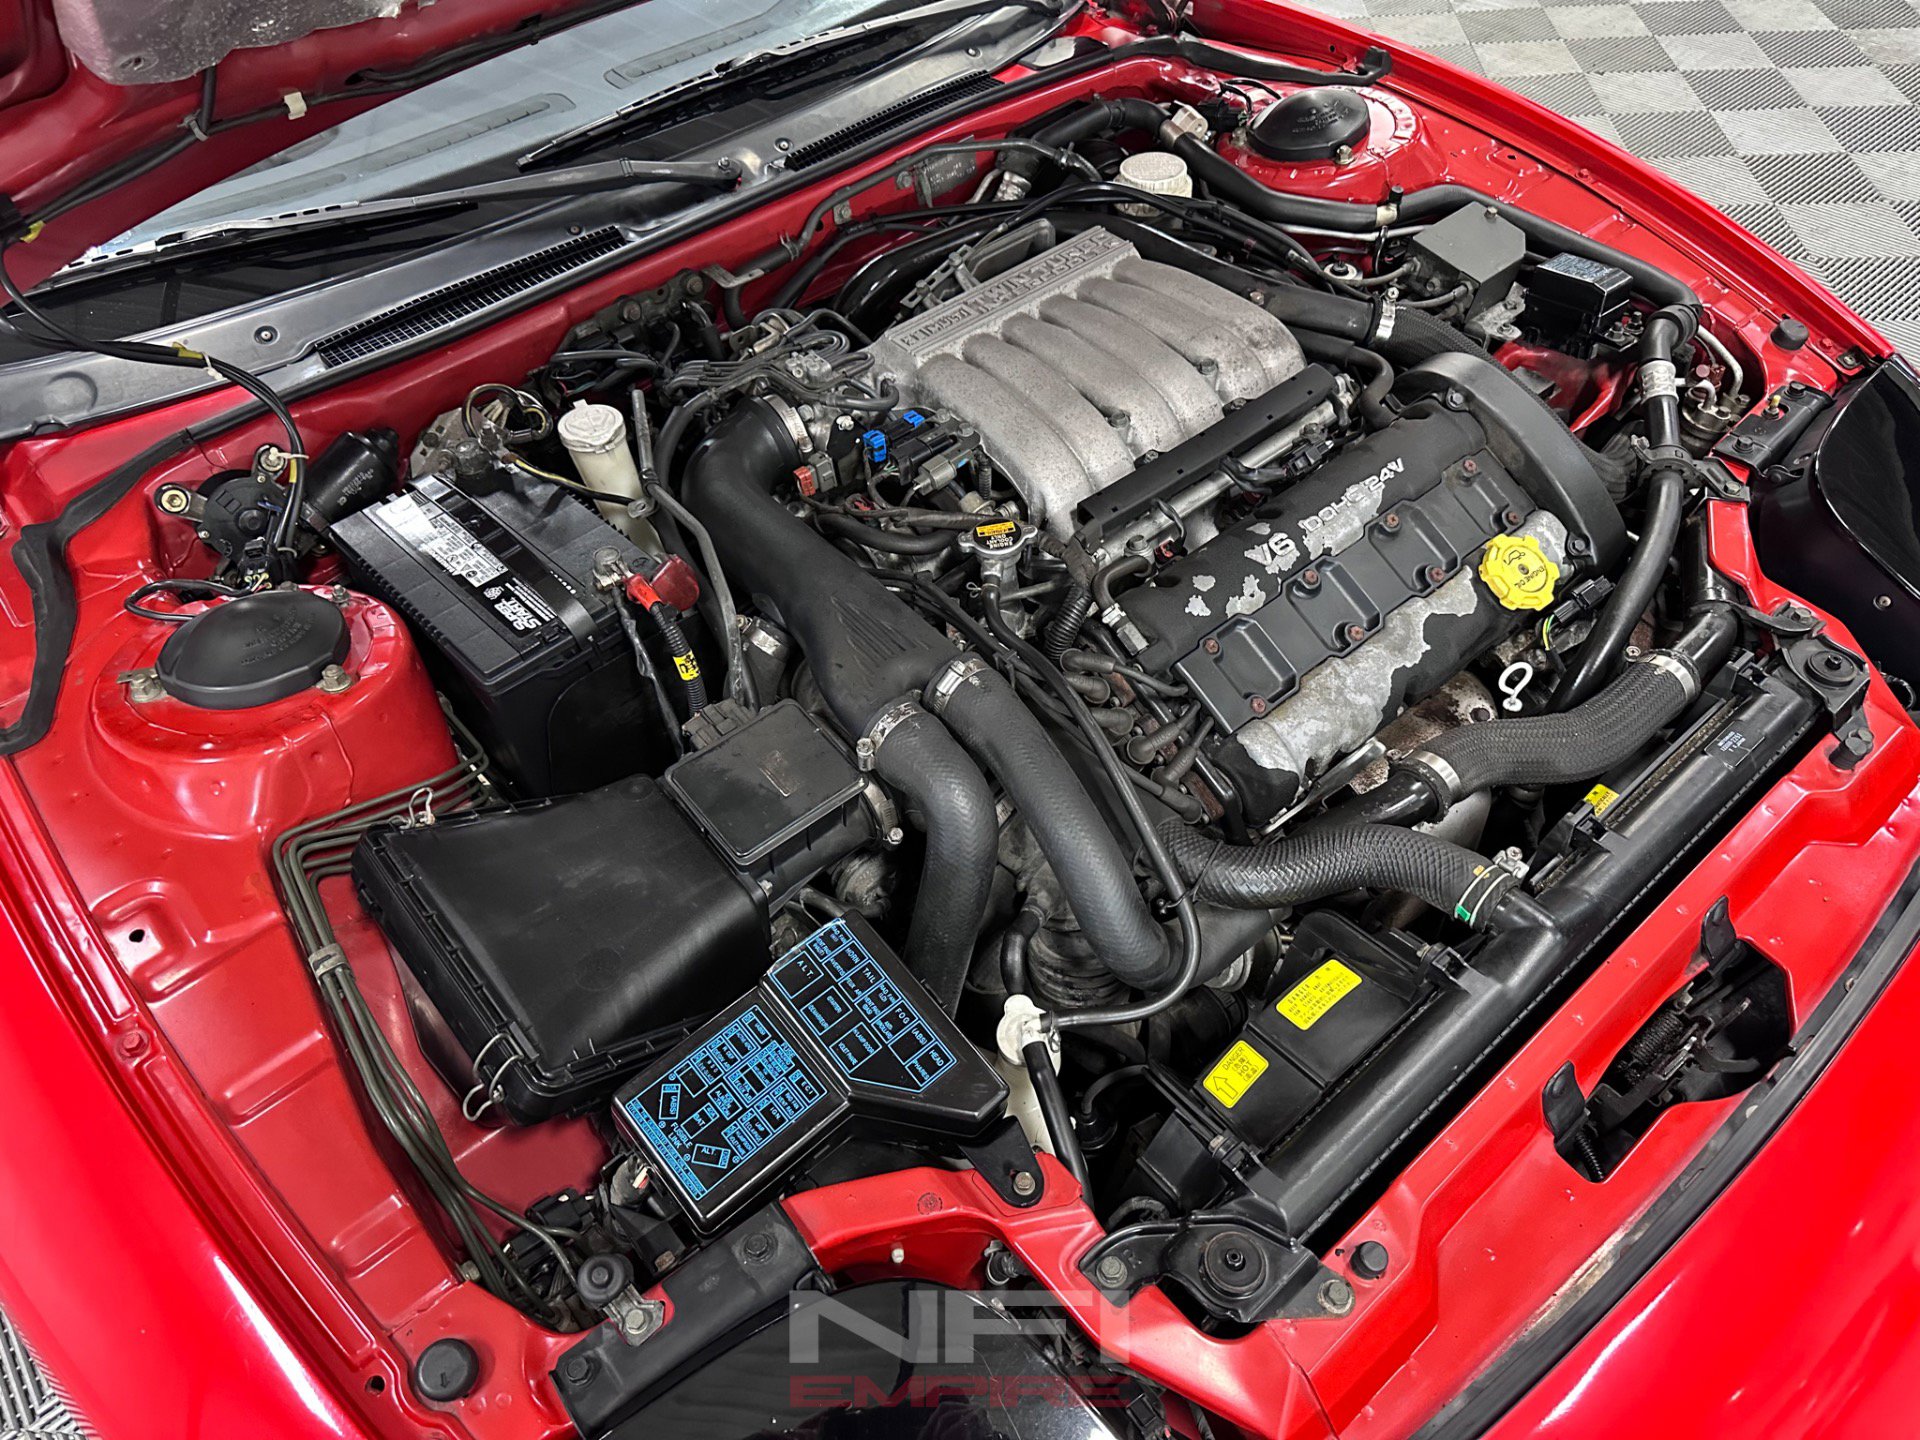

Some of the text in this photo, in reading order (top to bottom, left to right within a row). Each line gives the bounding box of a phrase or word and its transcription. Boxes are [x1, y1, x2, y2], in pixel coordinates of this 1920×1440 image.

[966, 229, 1109, 311] TWIN TURBO
[1244, 457, 1404, 566] V6 DOHC 24V
[1514, 565, 1546, 589] ENGINE OIL
[491, 599, 528, 632] SUPER
[498, 591, 543, 633] START
[844, 946, 860, 964] HORN
[796, 958, 814, 979] ALT.
[861, 966, 877, 983] TAIL
[894, 1007, 910, 1024] FOG
[910, 1027, 927, 1046] (ABS)
[779, 1041, 796, 1059] FUSE
[928, 1049, 944, 1067] HEAD
[1221, 1046, 1245, 1070] DANGER
[1236, 1059, 1253, 1076] HOT
[667, 1132, 682, 1148] LINK
[669, 1121, 693, 1148] FUSIBLE
